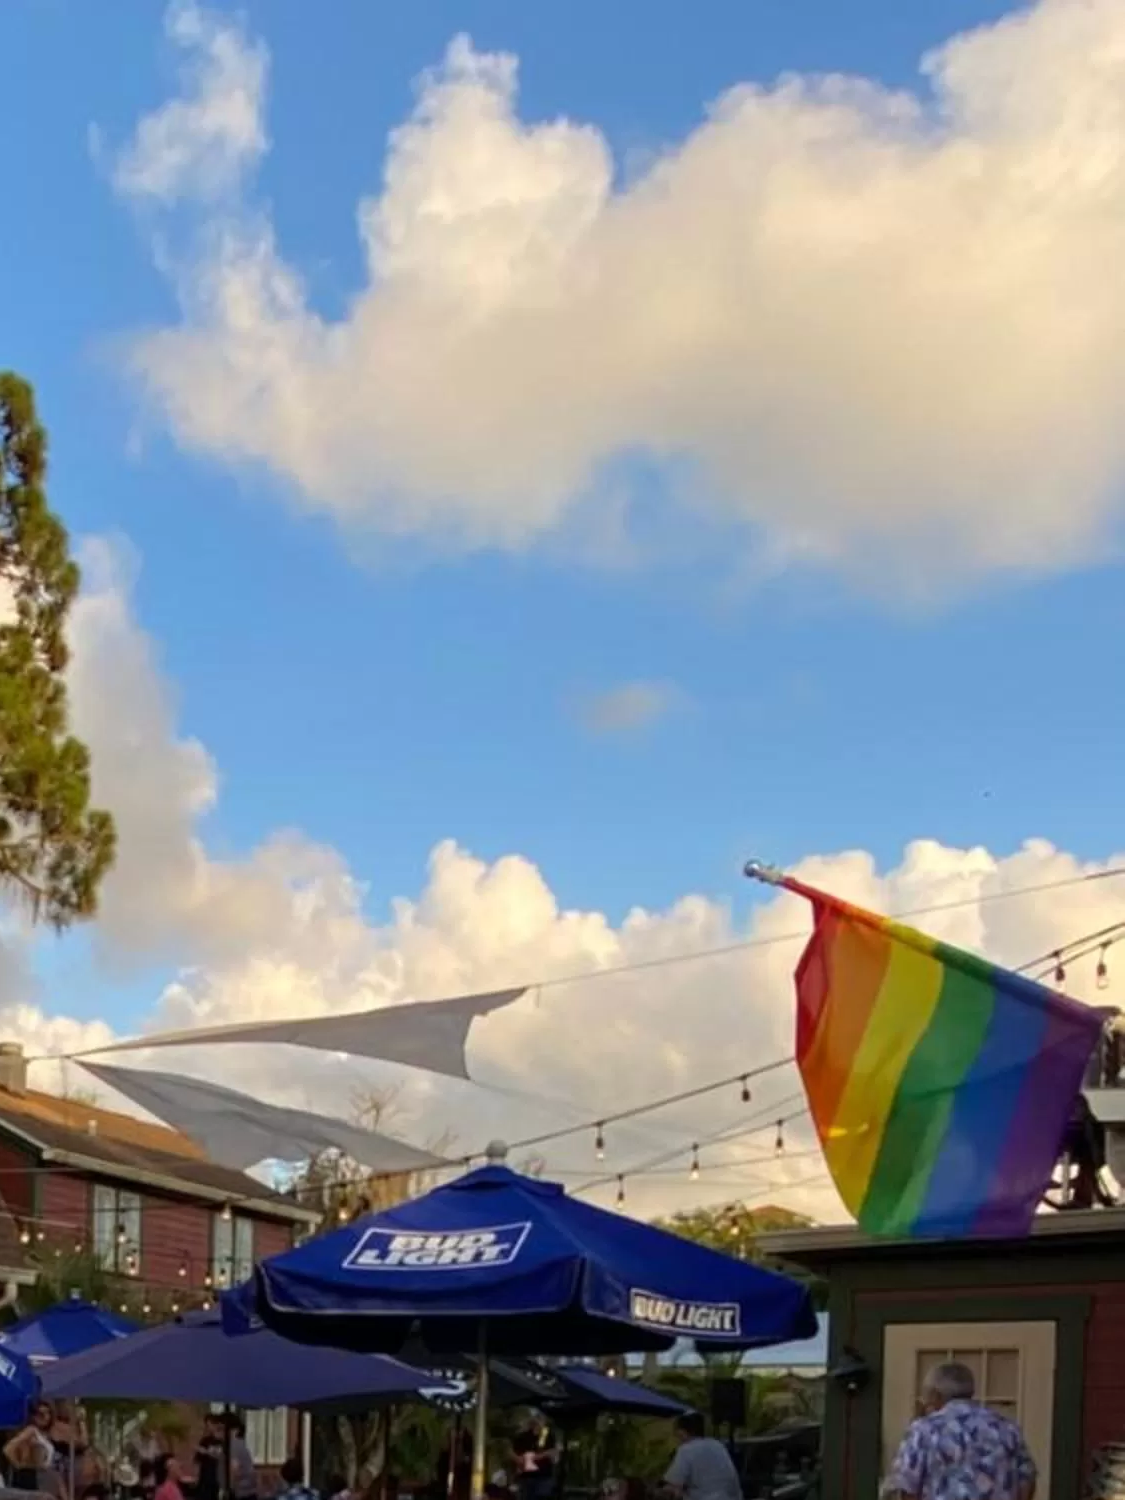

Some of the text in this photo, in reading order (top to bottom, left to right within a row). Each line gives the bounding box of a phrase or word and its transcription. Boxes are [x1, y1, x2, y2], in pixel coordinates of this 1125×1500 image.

[388, 1232, 497, 1251] BUD
[356, 1243, 512, 1265] LIGHT
[634, 1295, 735, 1331] BUD LIGHT
